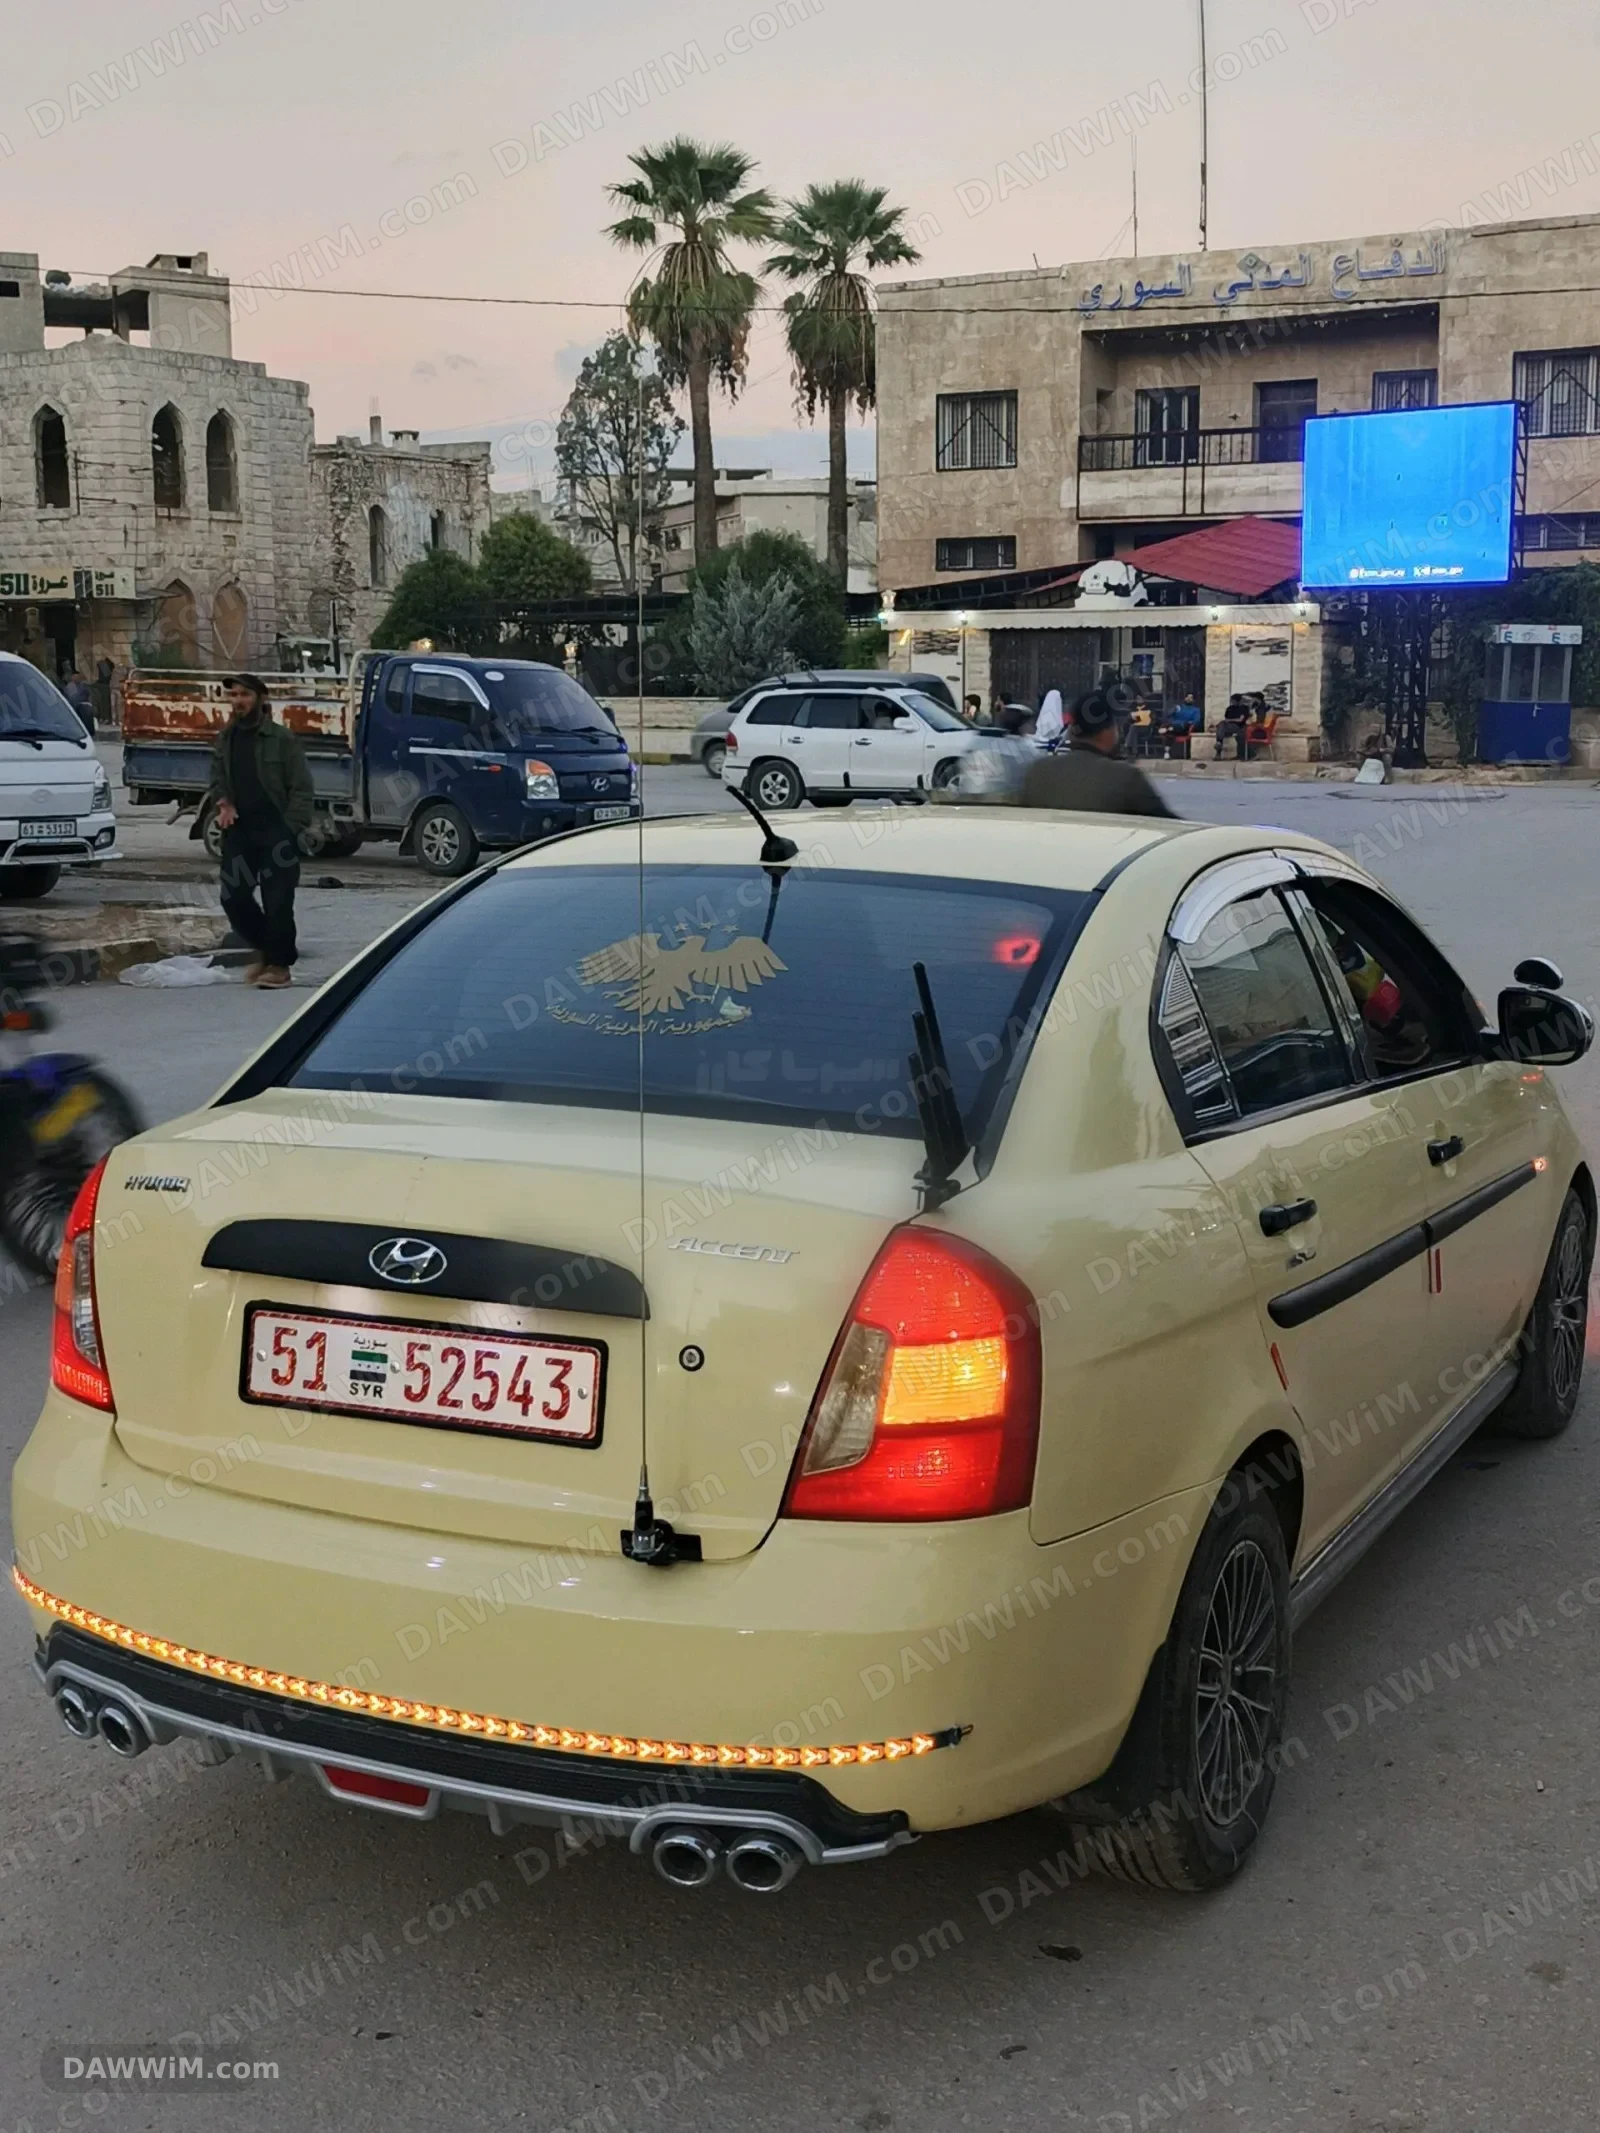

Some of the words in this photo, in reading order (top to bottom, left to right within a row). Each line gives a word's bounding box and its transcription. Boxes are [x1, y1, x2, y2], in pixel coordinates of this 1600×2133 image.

[1330, 236, 1446, 301] الدفاع
[1078, 262, 1192, 319] السوري
[0, 573, 30, 596] 511
[95, 583, 115, 596] 511
[667, 1235, 801, 1266] ACCENT
[353, 1332, 388, 1350] سورية
[270, 1326, 328, 1392] 51
[403, 1341, 573, 1421] 52543
[349, 1382, 383, 1399] SYR
